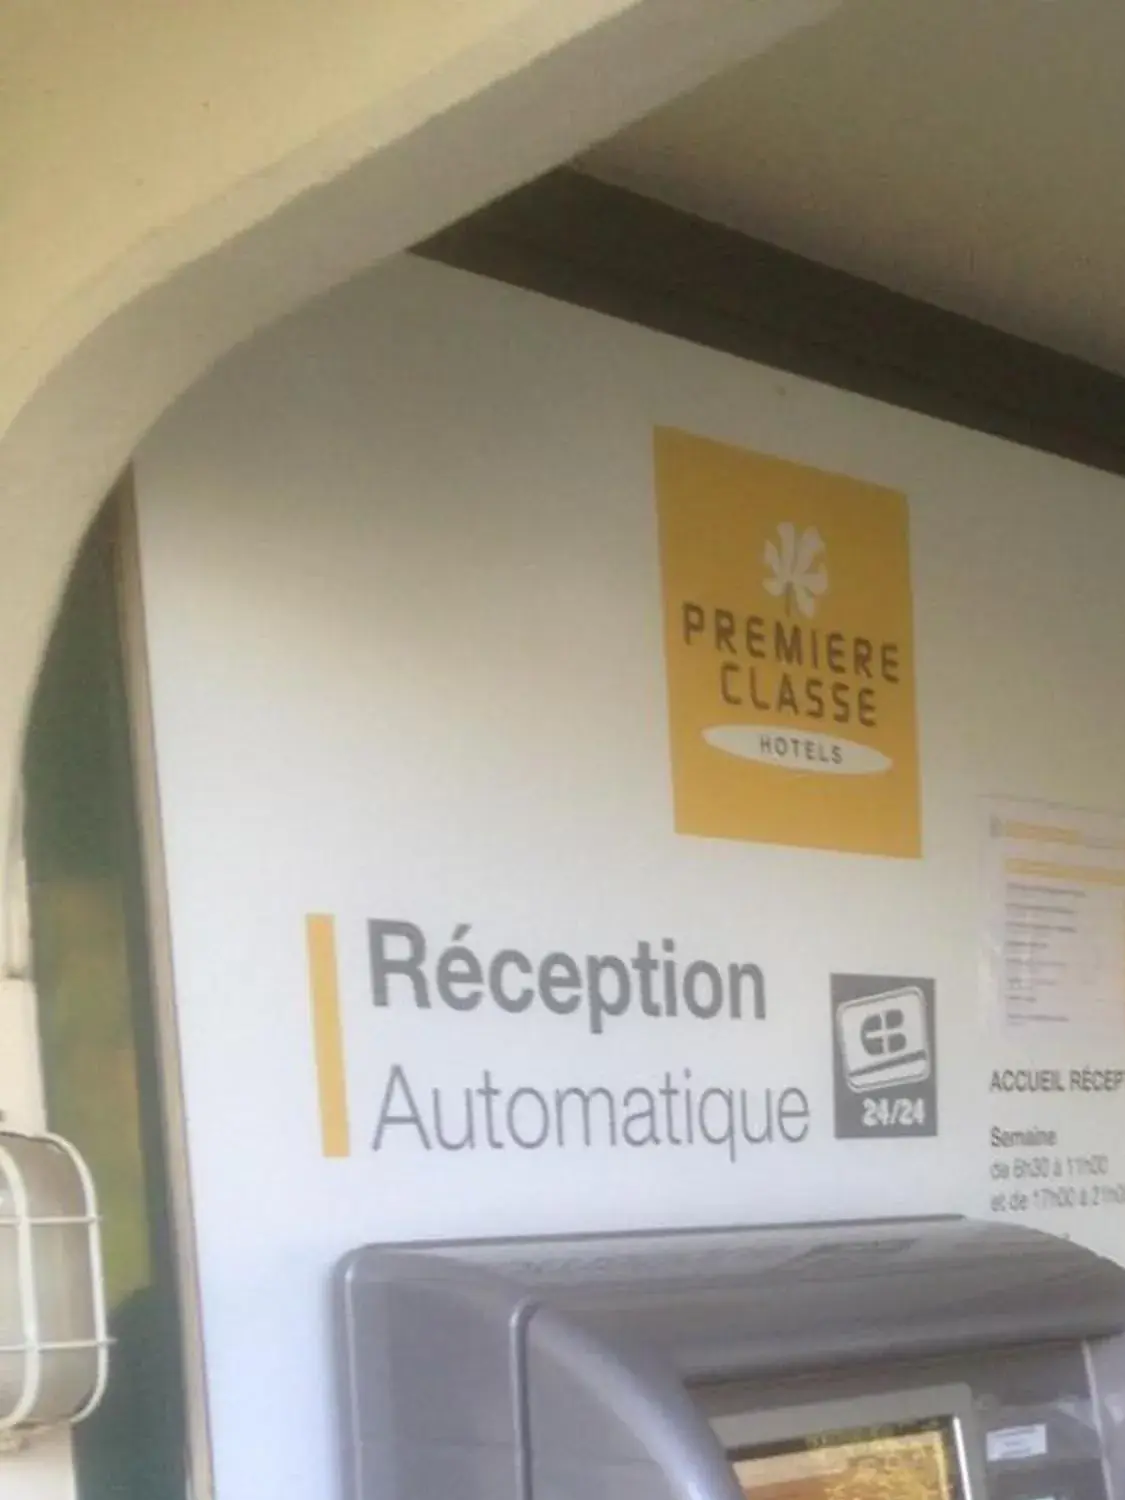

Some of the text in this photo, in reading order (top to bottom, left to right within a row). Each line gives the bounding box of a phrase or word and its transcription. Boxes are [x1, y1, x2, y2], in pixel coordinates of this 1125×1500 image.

[682, 603, 900, 684] PREMIERE
[720, 662, 878, 727] CLASSE
[759, 735, 844, 765] HOTELS
[366, 917, 768, 1035] Réception
[989, 1068, 1066, 1093] ACCUEIL
[370, 1064, 811, 1164] Automatique
[861, 1097, 926, 1127] 24/24
[990, 1125, 1058, 1148] Semaine
